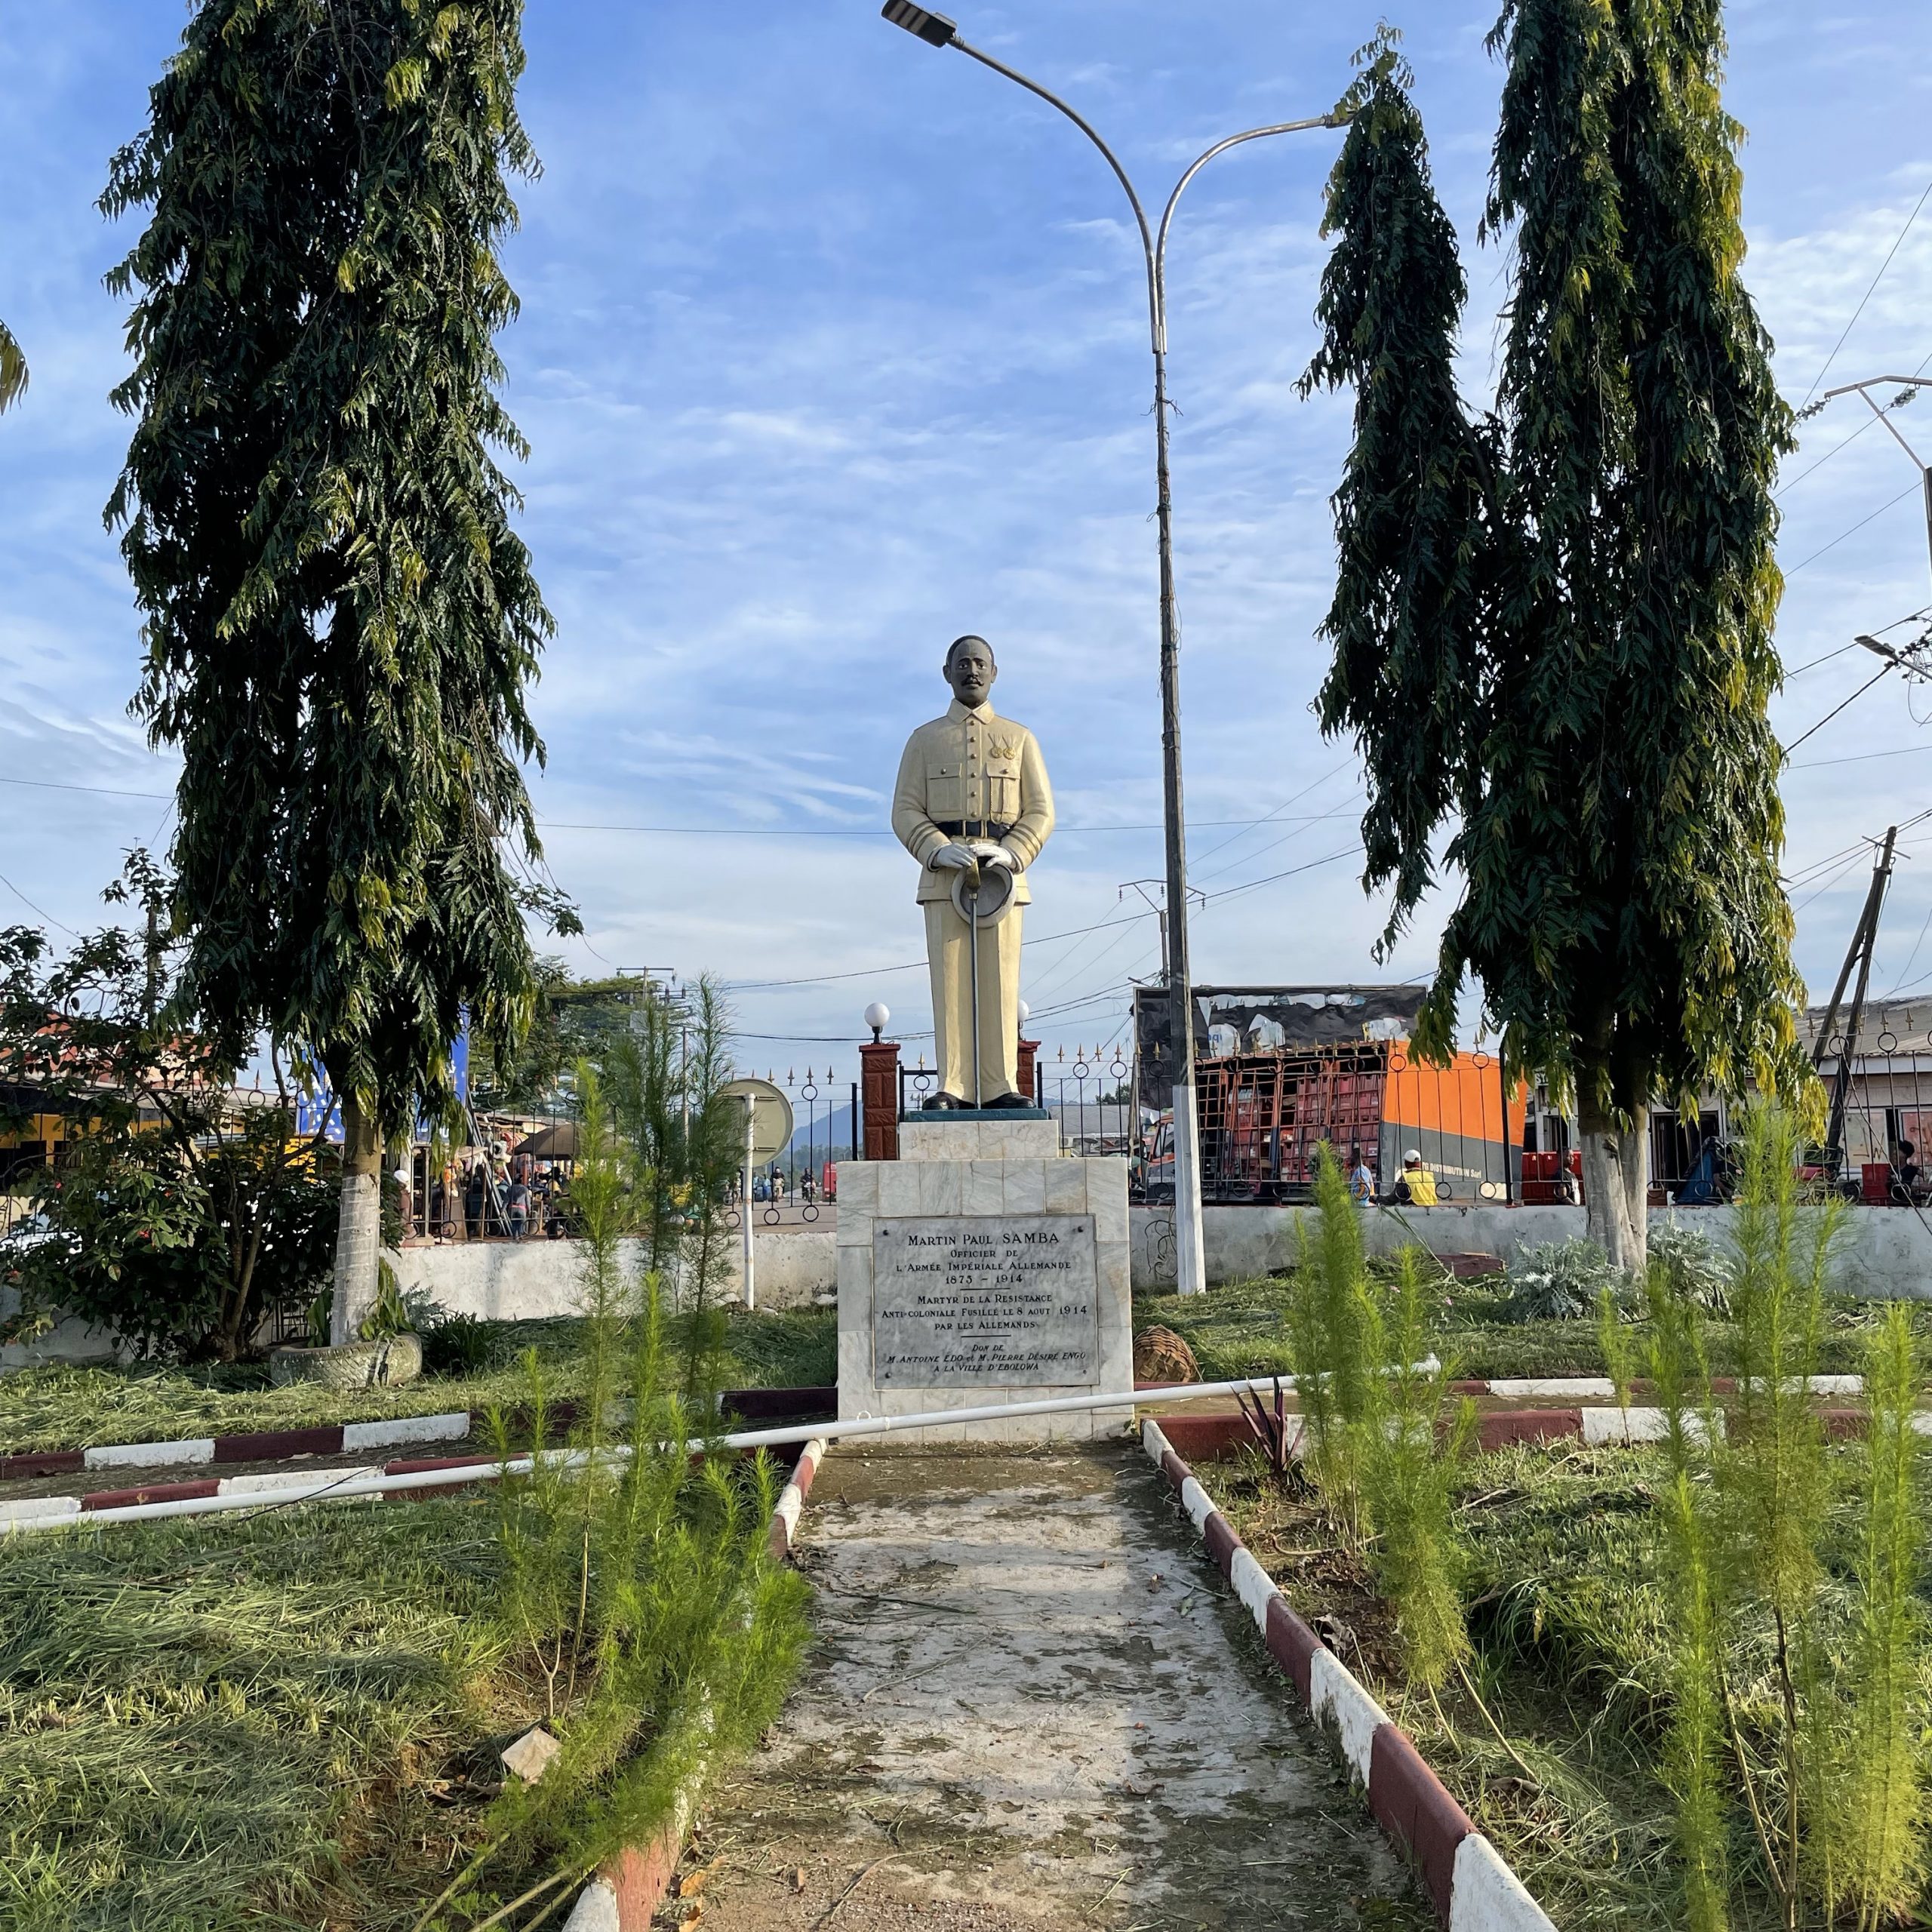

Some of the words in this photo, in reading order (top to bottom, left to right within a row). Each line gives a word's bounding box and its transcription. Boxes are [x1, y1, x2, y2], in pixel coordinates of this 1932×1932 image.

[1430, 1163, 1469, 1177] DISTRIBUTION
[908, 1235, 956, 1246] MARTIN
[963, 1234, 992, 1244] PAUL
[1002, 1232, 1060, 1244] SAMBA
[950, 1249, 996, 1258] OFFICIER
[948, 1262, 1003, 1271] IMPÉRIALE
[1009, 1262, 1072, 1270] ALLEMANDE
[946, 1275, 973, 1284] 1875
[996, 1274, 1023, 1283] 1914
[918, 1296, 959, 1305] MARTYR
[963, 1296, 975, 1304] DE
[995, 1294, 1052, 1303] RESISTANCE
[1017, 1307, 1023, 1315] 8
[1059, 1306, 1088, 1315] 1914
[900, 1355, 940, 1363] ANTOINE
[1062, 1352, 1086, 1360] ENGO
[987, 1363, 1039, 1371] D'EBOLOWA
